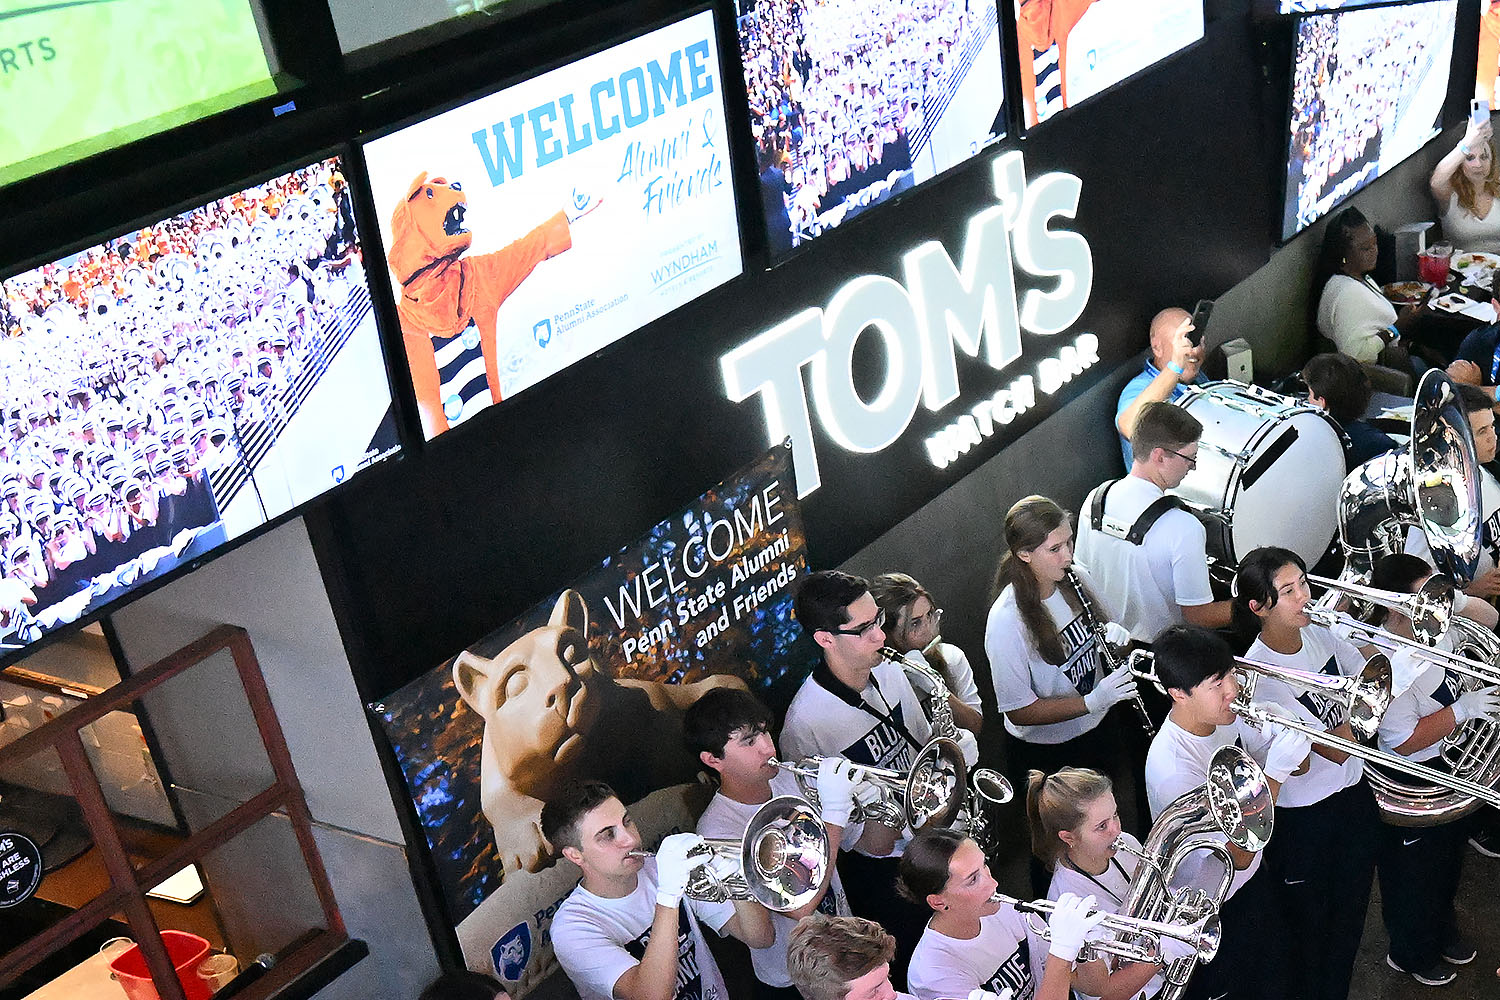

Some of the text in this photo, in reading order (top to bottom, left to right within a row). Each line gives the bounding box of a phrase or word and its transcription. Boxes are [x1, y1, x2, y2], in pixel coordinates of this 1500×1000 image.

[472, 39, 714, 188] WELCOME
[617, 118, 692, 183] Alumni
[643, 153, 723, 222] Friends
[650, 239, 718, 285] WYNDHAM
[720, 149, 1094, 500] TOM'S
[924, 332, 1100, 468] WATCH BAR
[603, 480, 784, 630] WELCOME
[622, 527, 790, 664] Penn State Alumni
[696, 562, 798, 648] and Friends
[865, 722, 903, 763] BLU
